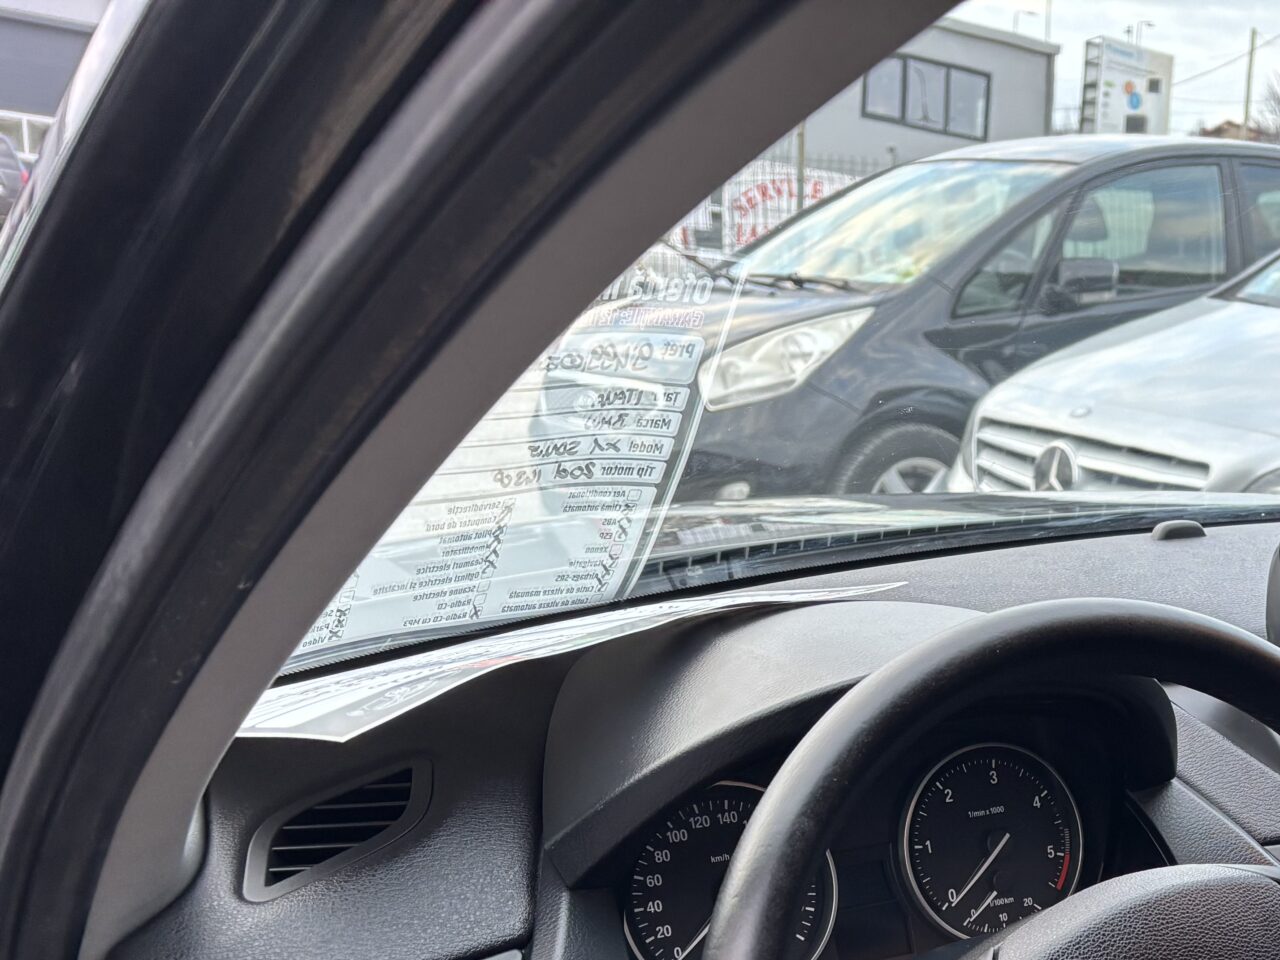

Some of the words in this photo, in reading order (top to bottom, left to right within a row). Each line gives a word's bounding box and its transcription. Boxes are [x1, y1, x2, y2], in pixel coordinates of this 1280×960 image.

[731, 176, 824, 218] SERVIE
[989, 771, 998, 784] 3
[944, 788, 954, 803] 2
[1033, 796, 1041, 808] 4
[689, 815, 711, 829] 120
[717, 811, 738, 825] 140
[666, 829, 689, 844] 100
[925, 840, 932, 854] 1
[1047, 845, 1055, 859] 5
[654, 849, 671, 863] 80
[711, 853, 730, 863] km/h
[646, 873, 663, 888] 60
[948, 888, 957, 902] 0
[1023, 897, 1033, 907] 20
[647, 899, 663, 913] 40
[999, 912, 1008, 921] 10
[656, 924, 672, 939] 20
[673, 947, 682, 960] 0
